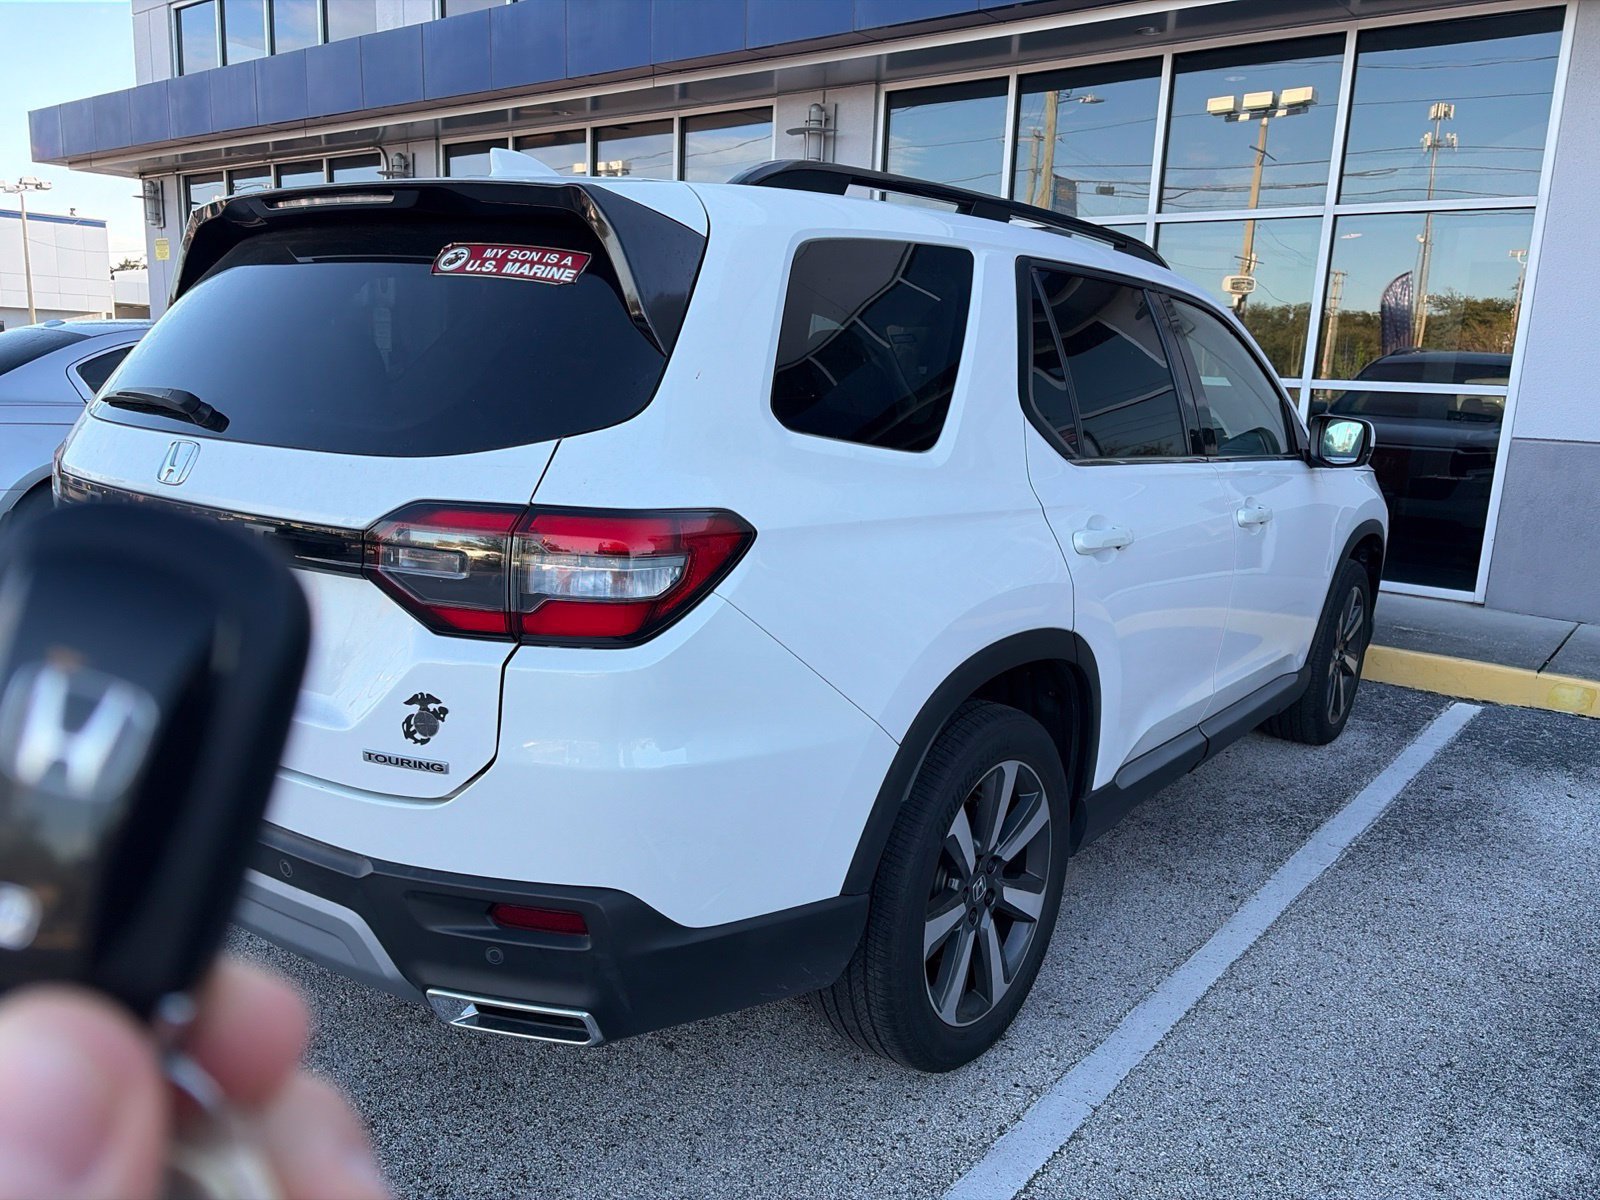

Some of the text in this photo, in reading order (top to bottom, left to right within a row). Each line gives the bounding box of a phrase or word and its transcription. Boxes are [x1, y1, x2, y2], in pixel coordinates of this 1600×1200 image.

[482, 248, 574, 266] MY SON IS A
[465, 259, 578, 283] U.S. MARINE
[364, 751, 444, 772] TOURING
